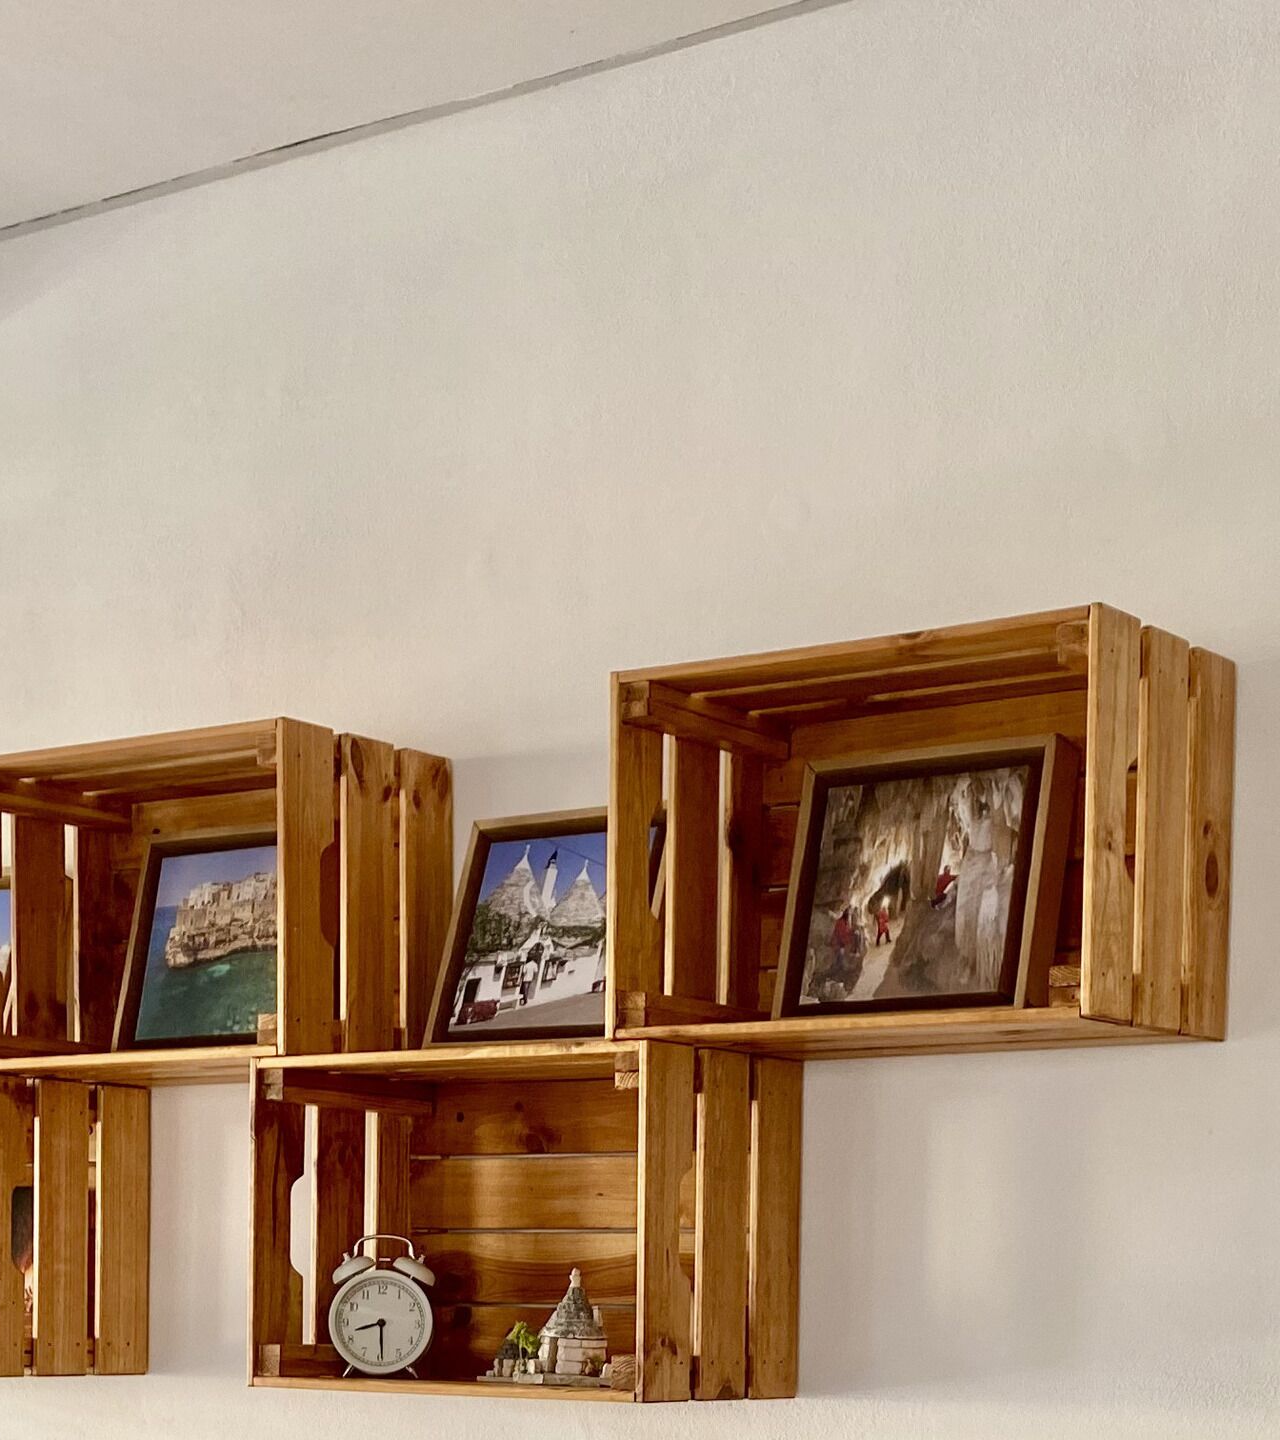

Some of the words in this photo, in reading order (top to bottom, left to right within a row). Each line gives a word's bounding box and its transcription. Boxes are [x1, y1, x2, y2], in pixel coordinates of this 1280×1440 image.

[362, 1290, 370, 1300] 11
[378, 1285, 388, 1295] 12
[349, 1302, 359, 1312] 10
[409, 1302, 416, 1312] 2
[361, 1346, 368, 1357] 7
